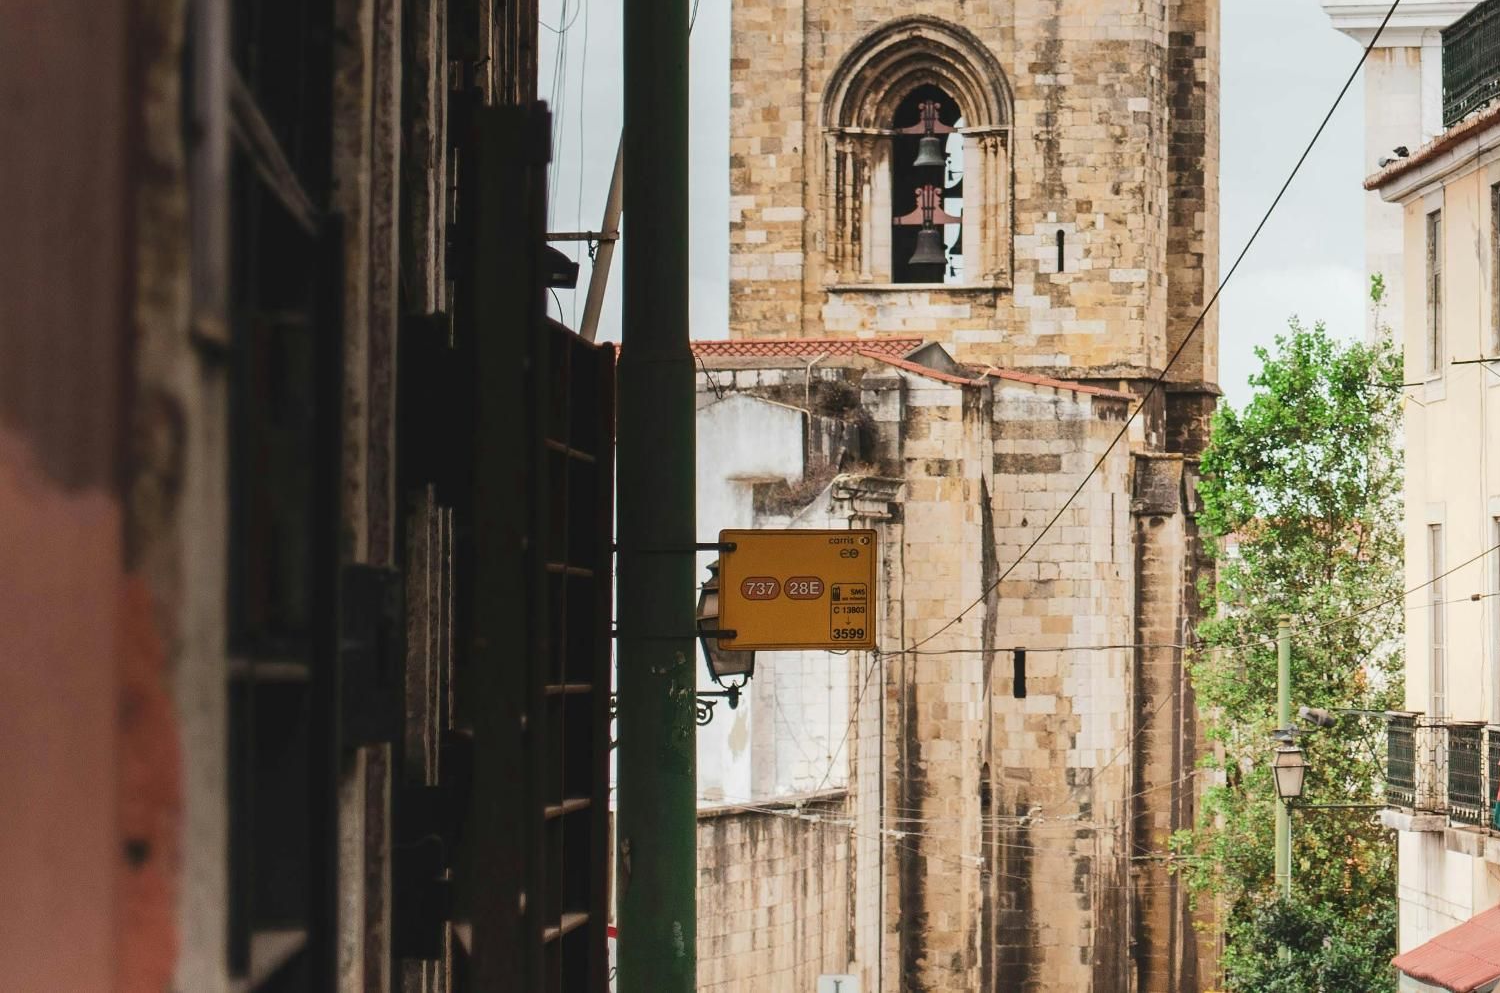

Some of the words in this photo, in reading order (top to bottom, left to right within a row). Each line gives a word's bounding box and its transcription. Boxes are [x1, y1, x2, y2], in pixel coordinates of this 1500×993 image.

[828, 536, 854, 545] carris
[746, 582, 775, 595] 737
[789, 581, 819, 595] 28E
[833, 606, 840, 614] C
[833, 628, 864, 639] 3599
